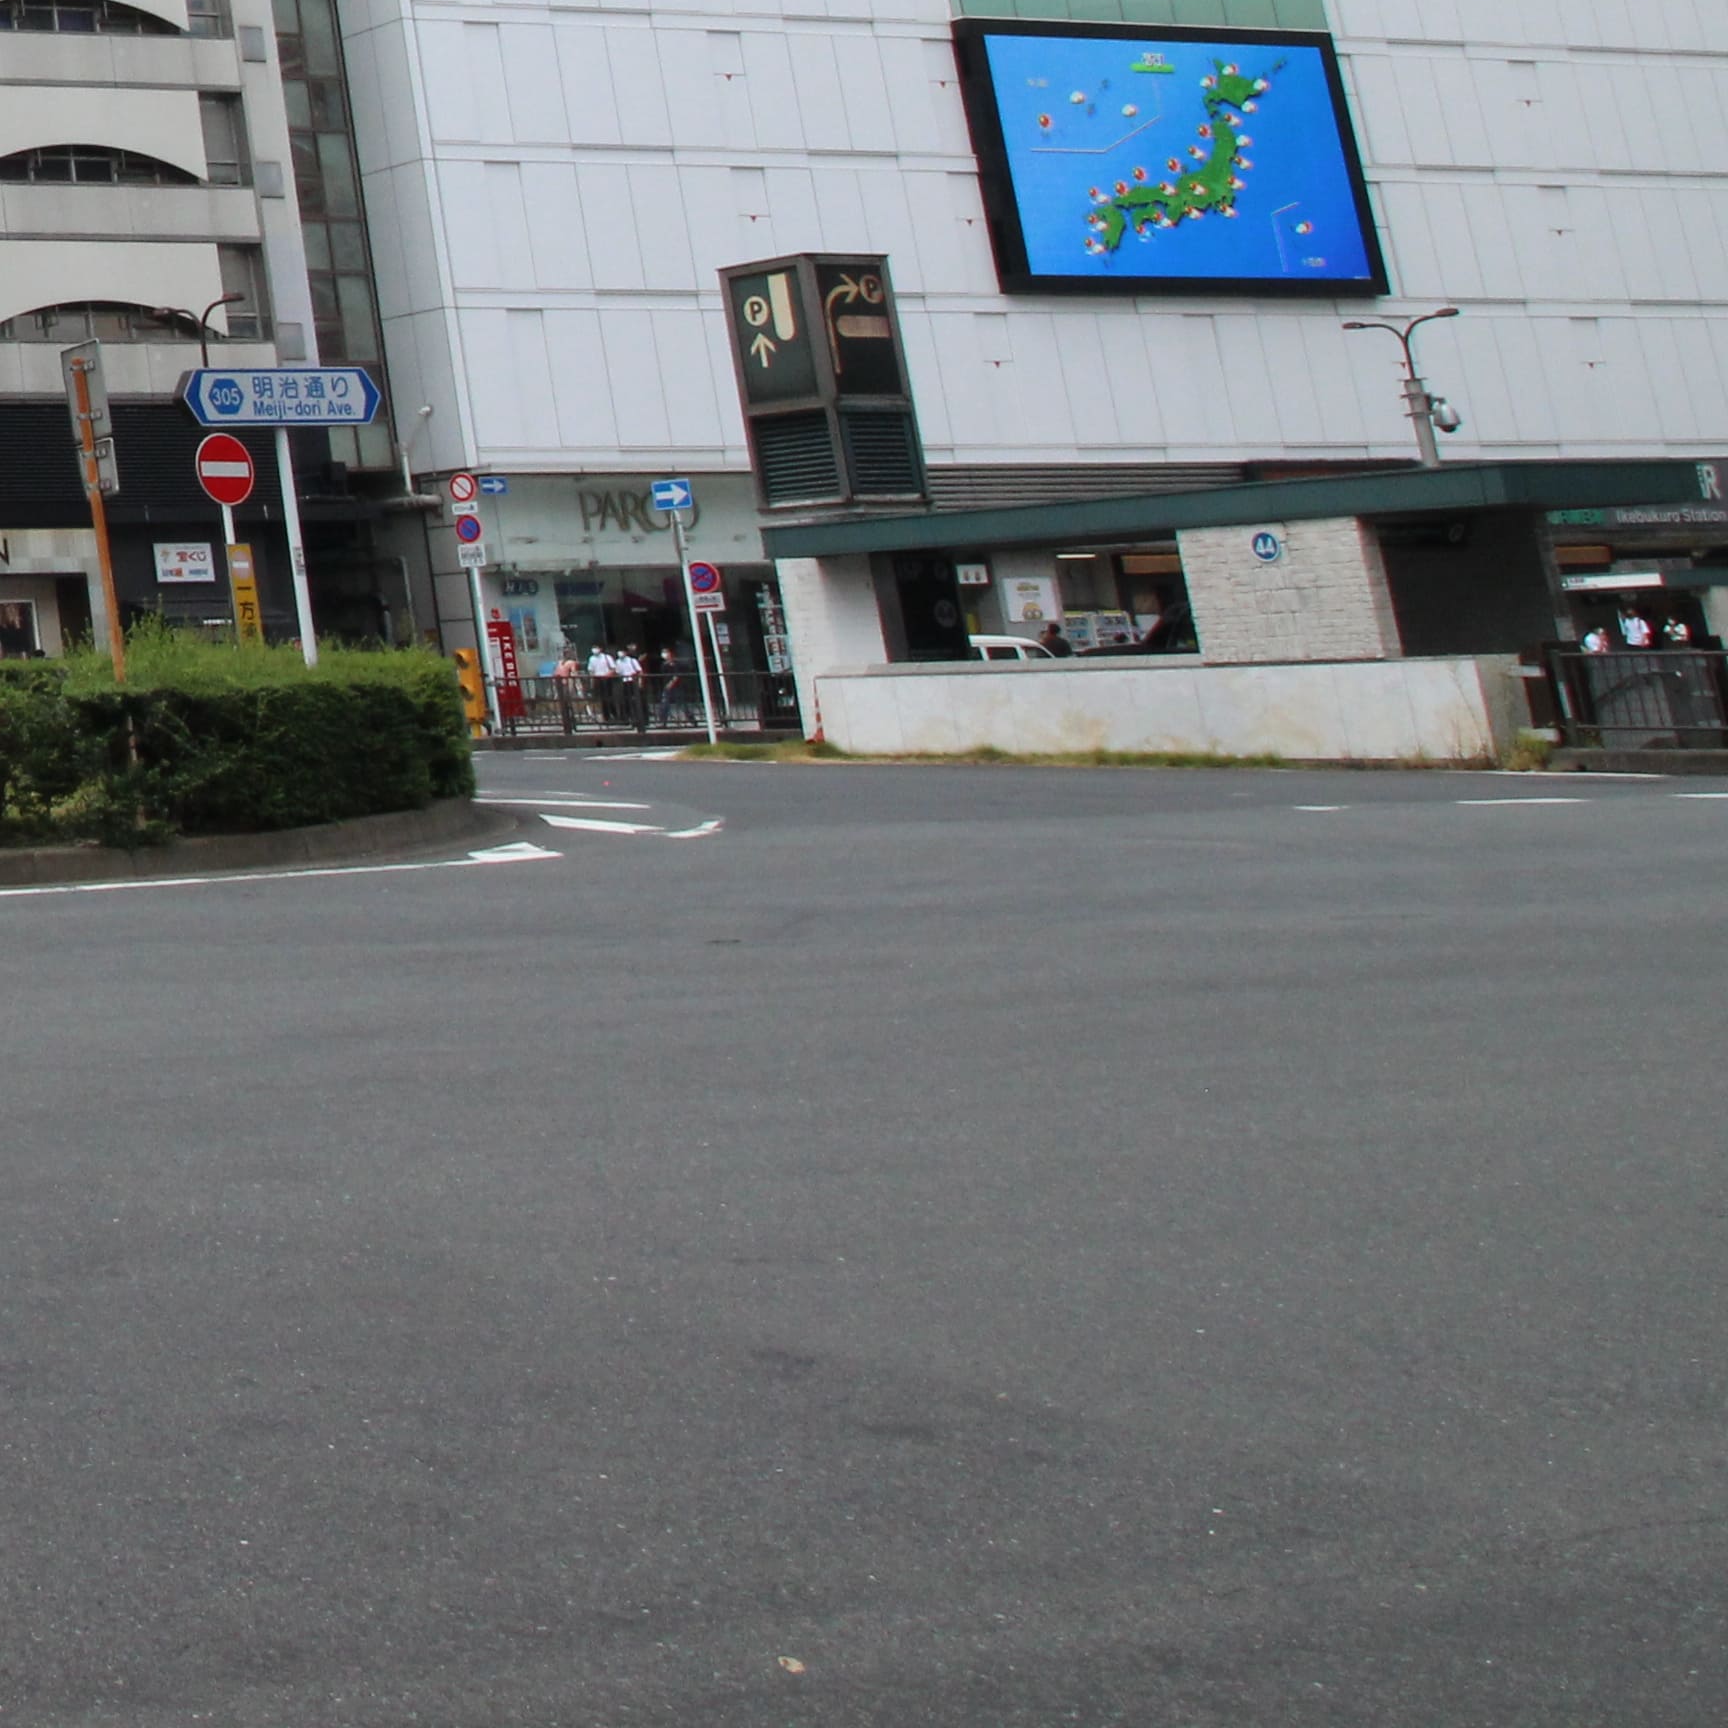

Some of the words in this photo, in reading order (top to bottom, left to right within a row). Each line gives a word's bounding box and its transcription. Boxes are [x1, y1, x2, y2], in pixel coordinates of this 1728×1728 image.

[213, 387, 240, 405] 305
[252, 376, 349, 399] 明治通り
[253, 400, 322, 419] Meiji-dori
[328, 400, 356, 415] Ave.
[1615, 509, 1680, 524] Ikebukuro
